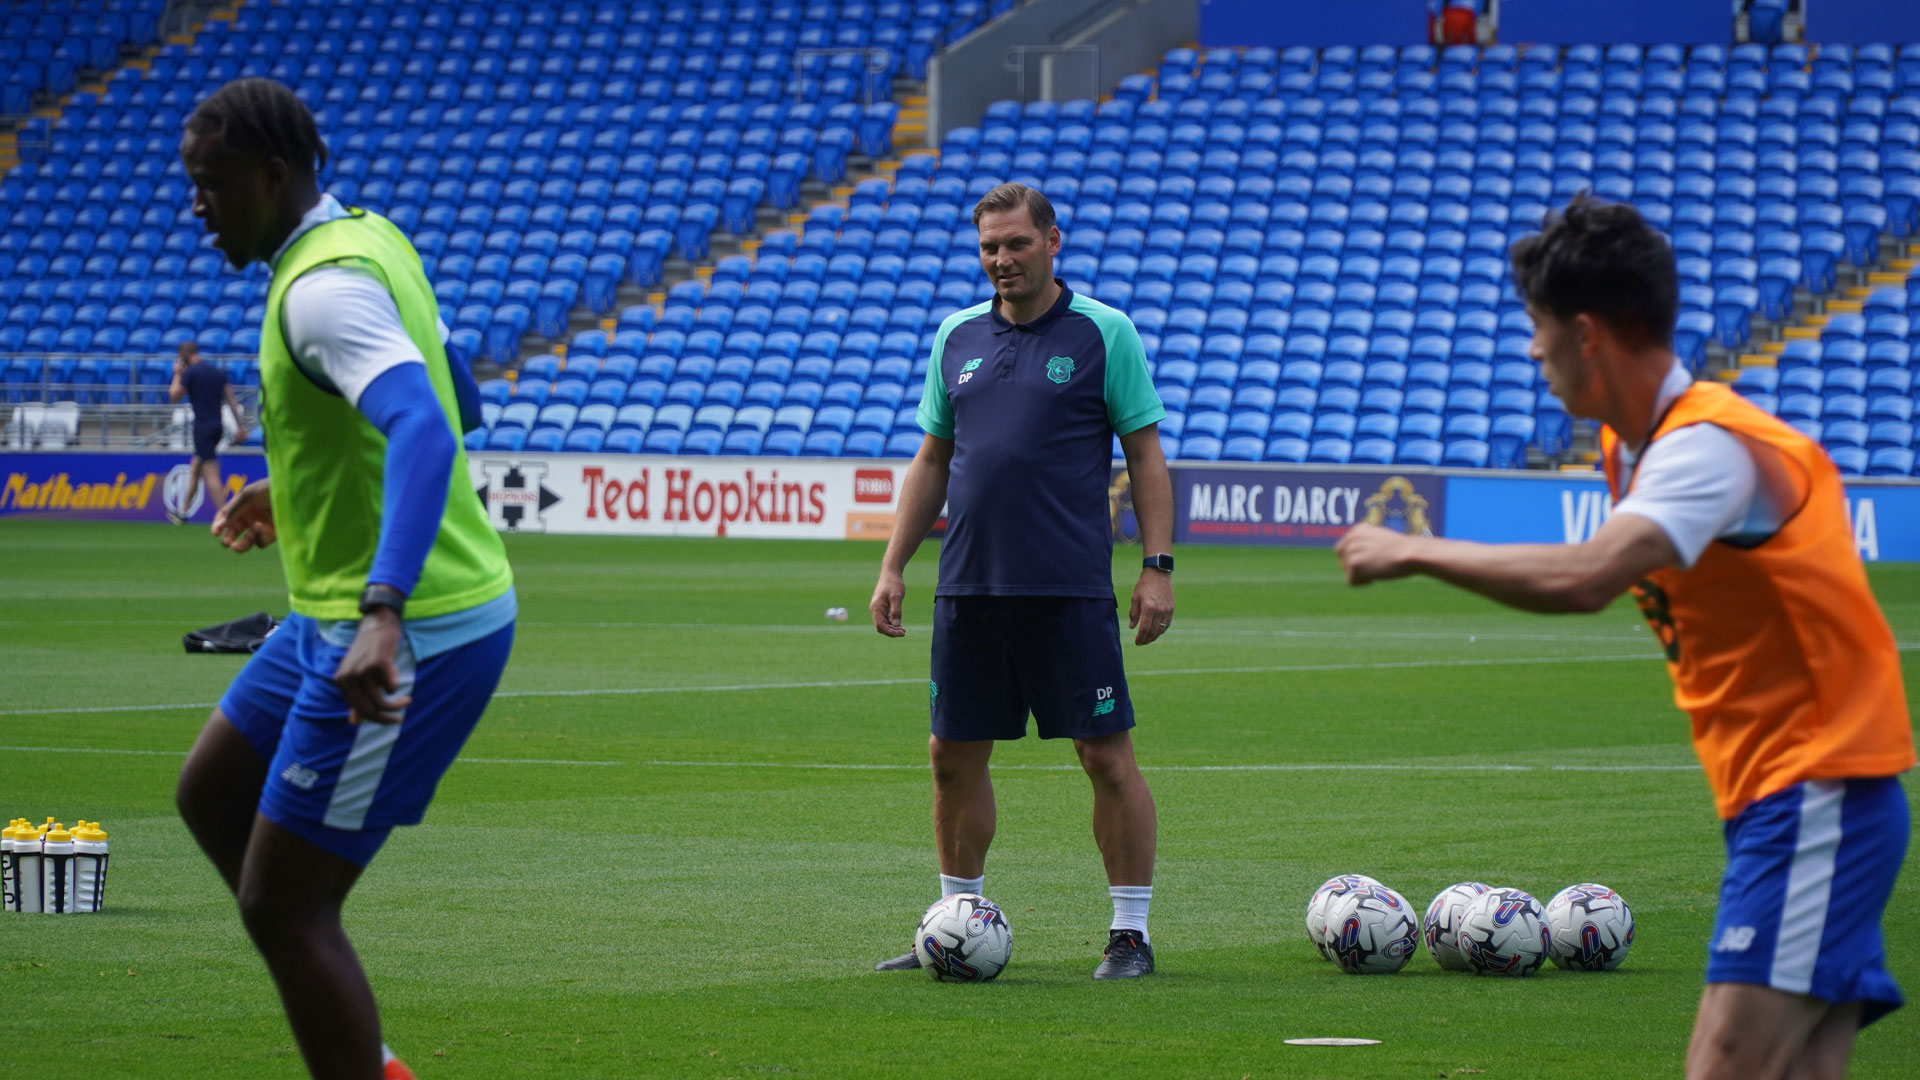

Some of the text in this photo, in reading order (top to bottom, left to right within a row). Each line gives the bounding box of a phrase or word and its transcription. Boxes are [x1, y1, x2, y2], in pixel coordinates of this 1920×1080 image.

[958, 372, 974, 385] DP
[0, 472, 157, 510] Nathaniel
[856, 477, 892, 496] TORO
[488, 489, 538, 505] HOPKINS
[582, 466, 827, 537] Ted Hopkins
[1189, 482, 1361, 525] MARC DARCY
[1096, 686, 1113, 701] DP
